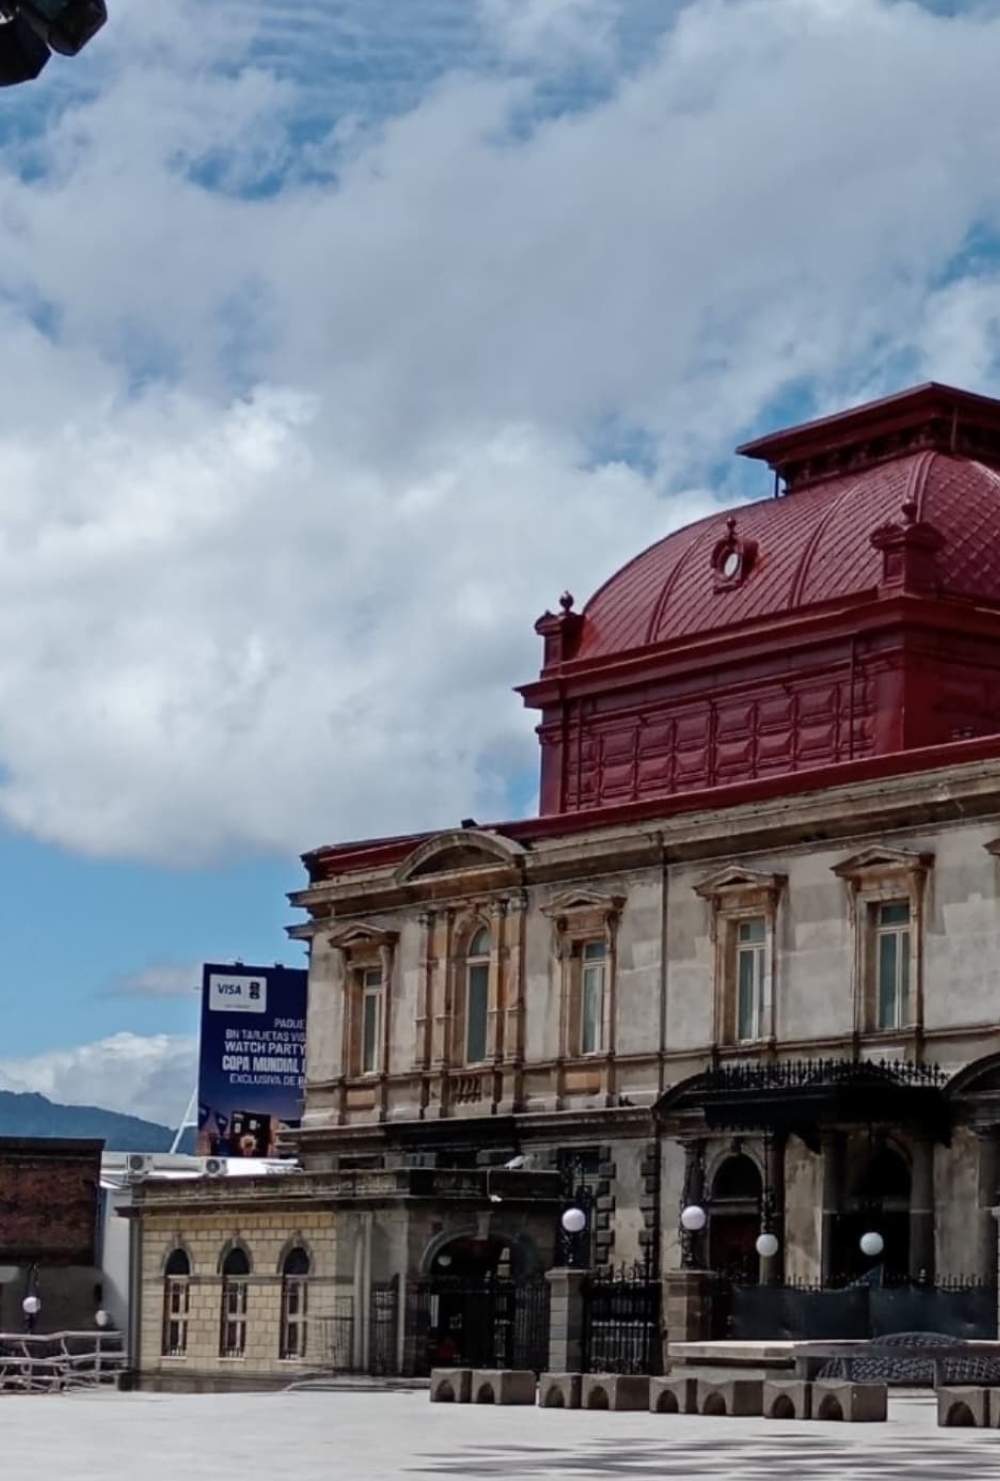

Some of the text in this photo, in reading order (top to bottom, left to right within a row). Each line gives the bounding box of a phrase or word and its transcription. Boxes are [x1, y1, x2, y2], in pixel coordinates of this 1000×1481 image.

[218, 983, 242, 996] VISA
[242, 1029, 289, 1042] TARJETAS
[224, 1041, 306, 1057] WATCH PARTY
[222, 1055, 250, 1072] COPA
[253, 1057, 299, 1074] MUNDIAL
[229, 1073, 282, 1086] EXCLUSIVA
[283, 1076, 296, 1087] DE
